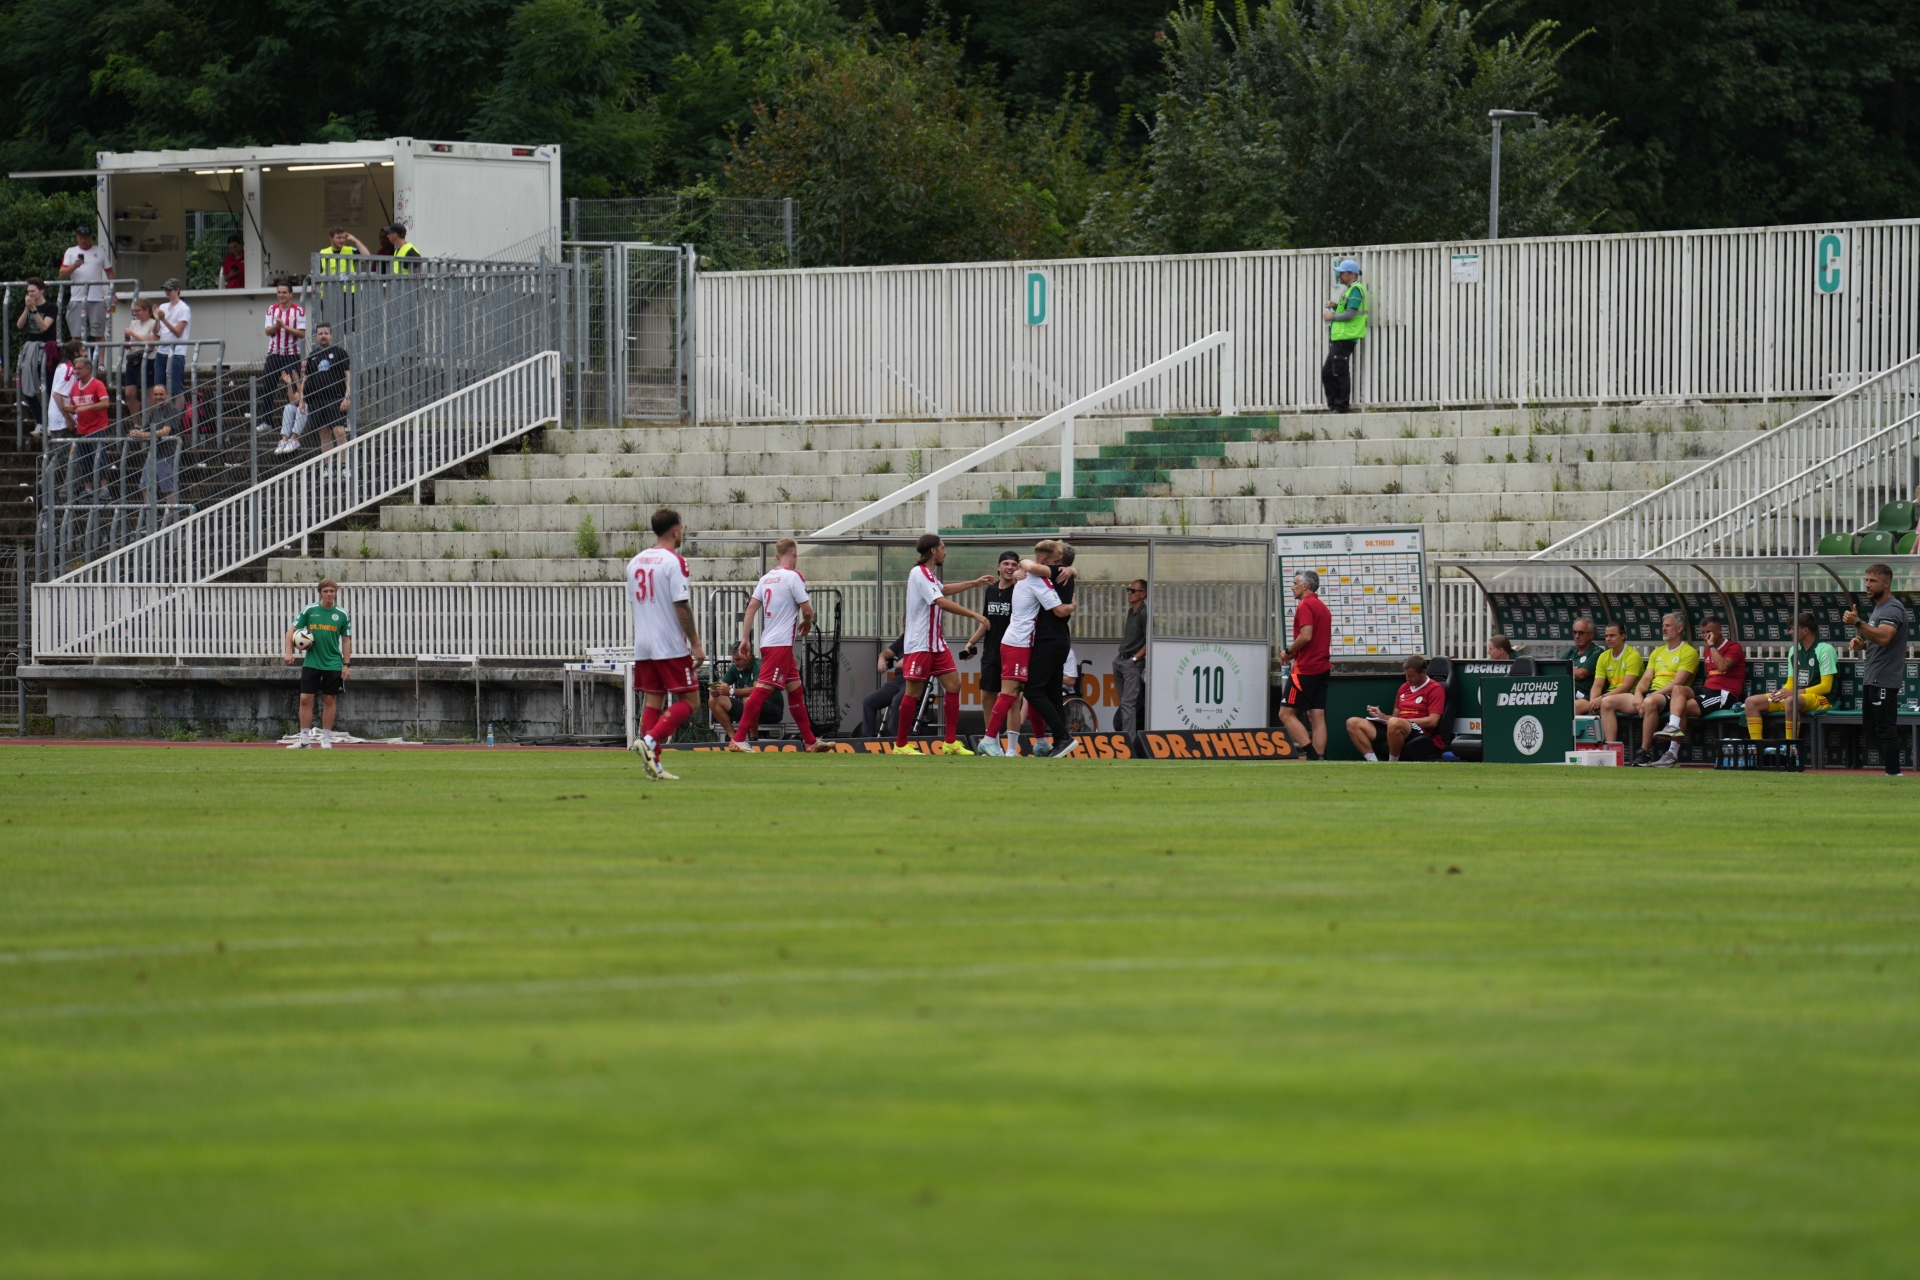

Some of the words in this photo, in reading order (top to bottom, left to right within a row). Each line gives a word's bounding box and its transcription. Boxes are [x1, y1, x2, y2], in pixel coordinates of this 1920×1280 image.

[1819, 234, 1841, 293] C
[1027, 273, 1046, 325] D
[634, 568, 655, 604] 31
[763, 588, 773, 618] 2
[1193, 666, 1224, 704] 110
[1497, 692, 1558, 706] DECKERT
[1511, 682, 1559, 692] AUTOHAUS
[1146, 731, 1292, 759] DR.THEISS
